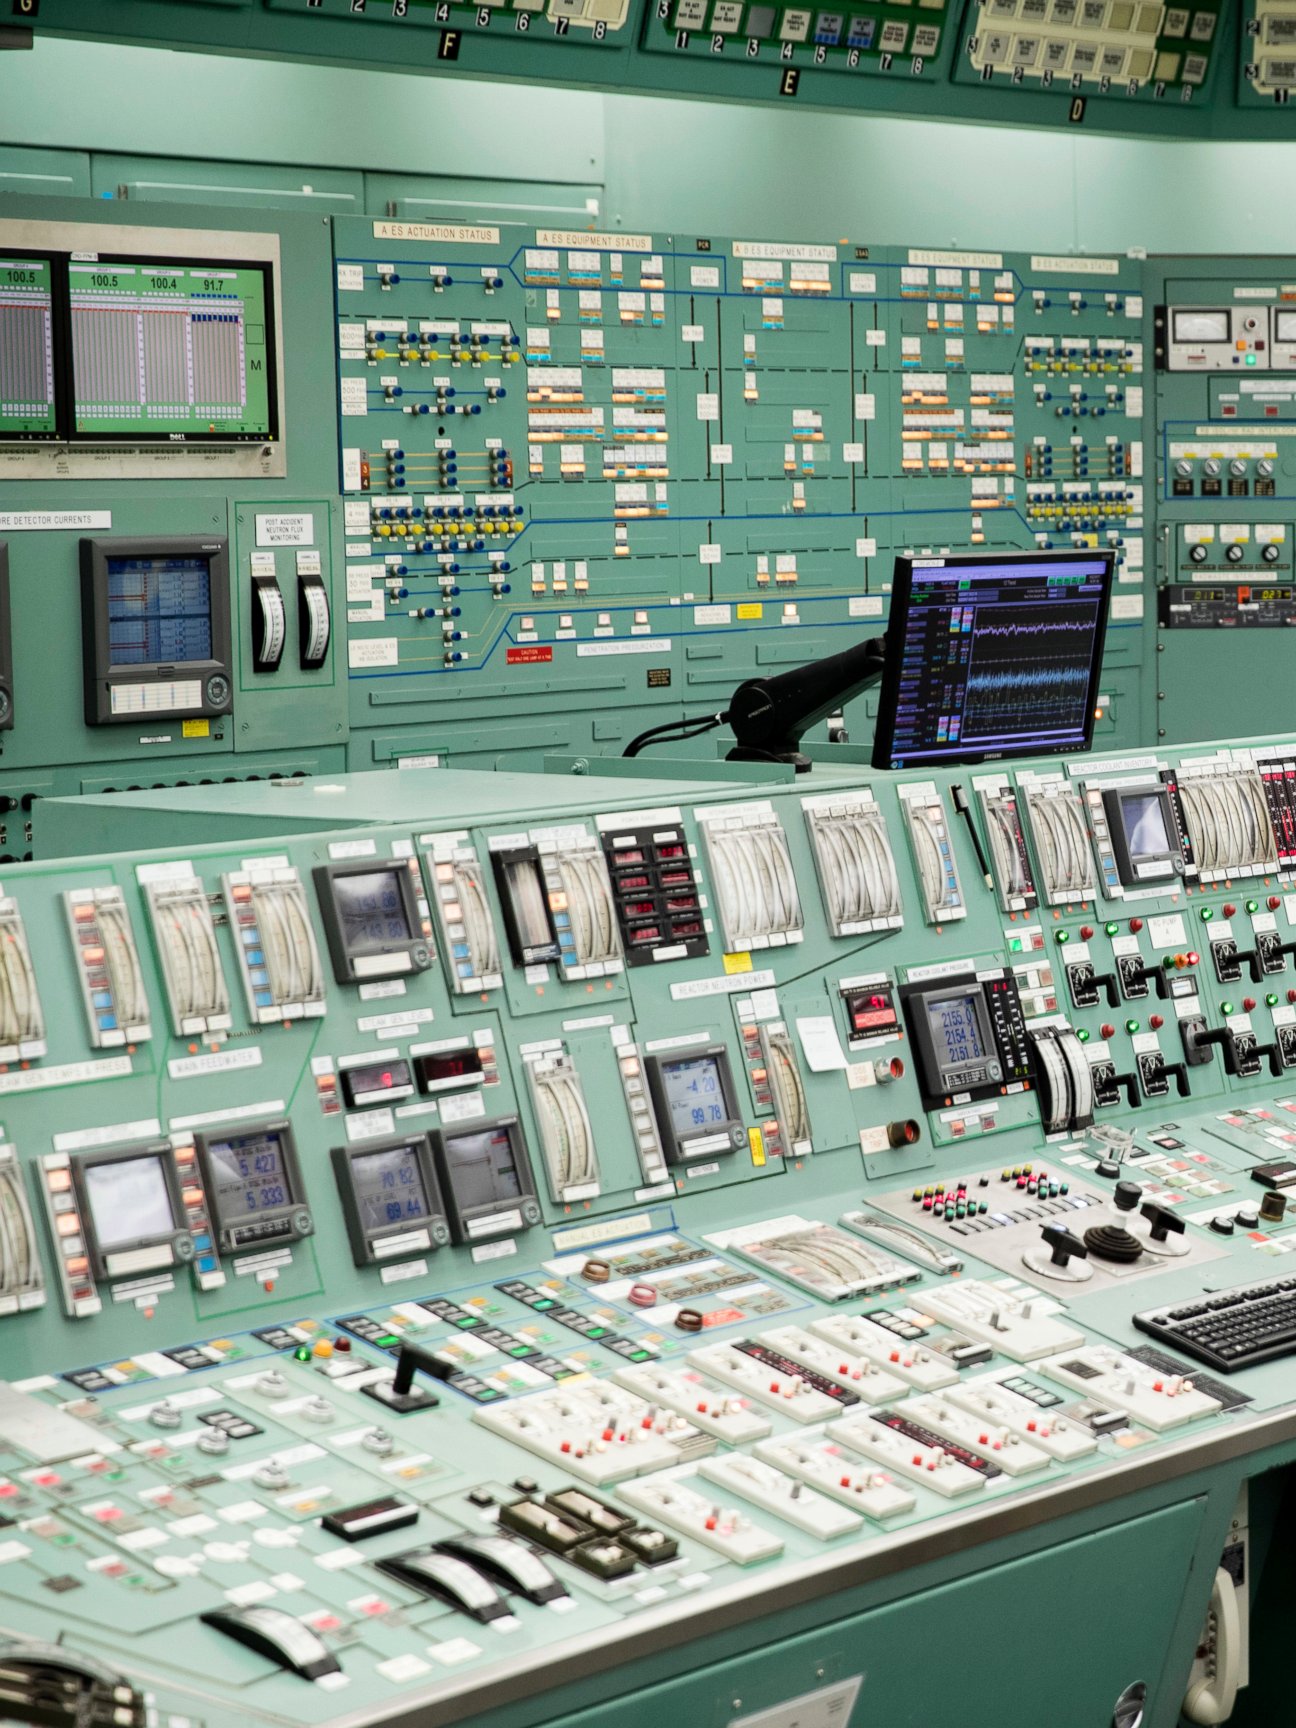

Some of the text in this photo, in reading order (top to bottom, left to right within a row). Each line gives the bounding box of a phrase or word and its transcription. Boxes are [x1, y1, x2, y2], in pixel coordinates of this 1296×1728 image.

[660, 2, 668, 18] 3
[396, 0, 406, 16] 3
[439, 5, 448, 21] 4
[479, 10, 488, 26] 5
[519, 14, 528, 30] 6
[558, 18, 568, 34] 7
[595, 22, 605, 38] 8
[1248, 21, 1258, 35] 2
[444, 33, 456, 56] F
[681, 32, 924, 74] 1 2 3 4 5 6 7 8
[784, 70, 796, 93] E
[1279, 89, 1286, 103] 1
[1072, 99, 1082, 120] D
[382, 226, 492, 241] A ES ACTUATION STATUS
[543, 234, 646, 248] A ES EQUIPMENT STATUS
[762, 246, 806, 256] EQUIPMENT
[808, 248, 835, 258] STATUS
[930, 255, 970, 264] EQUIPMENT
[973, 257, 998, 266] STATUS
[1088, 262, 1114, 270] STATUS
[7, 271, 36, 284] 100.5
[91, 275, 224, 292] 100.5 100.4 91.7
[251, 360, 262, 370] M
[14, 516, 52, 525] DETECTOR
[54, 514, 92, 524] CURRENTS
[584, 642, 666, 654] PENETRATION PRESSURIZATION
[1100, 762, 1122, 771] COOLANT
[1124, 759, 1152, 769] INVENTORY
[678, 974, 767, 996] REACTOR NEUTRON POWER
[942, 1007, 972, 1028] 2155.0
[945, 1028, 976, 1046] 2154.4
[950, 1046, 980, 1062] 2151.8
[176, 1053, 254, 1072] MAIN FEEDWATER
[692, 1104, 722, 1124] 99.78
